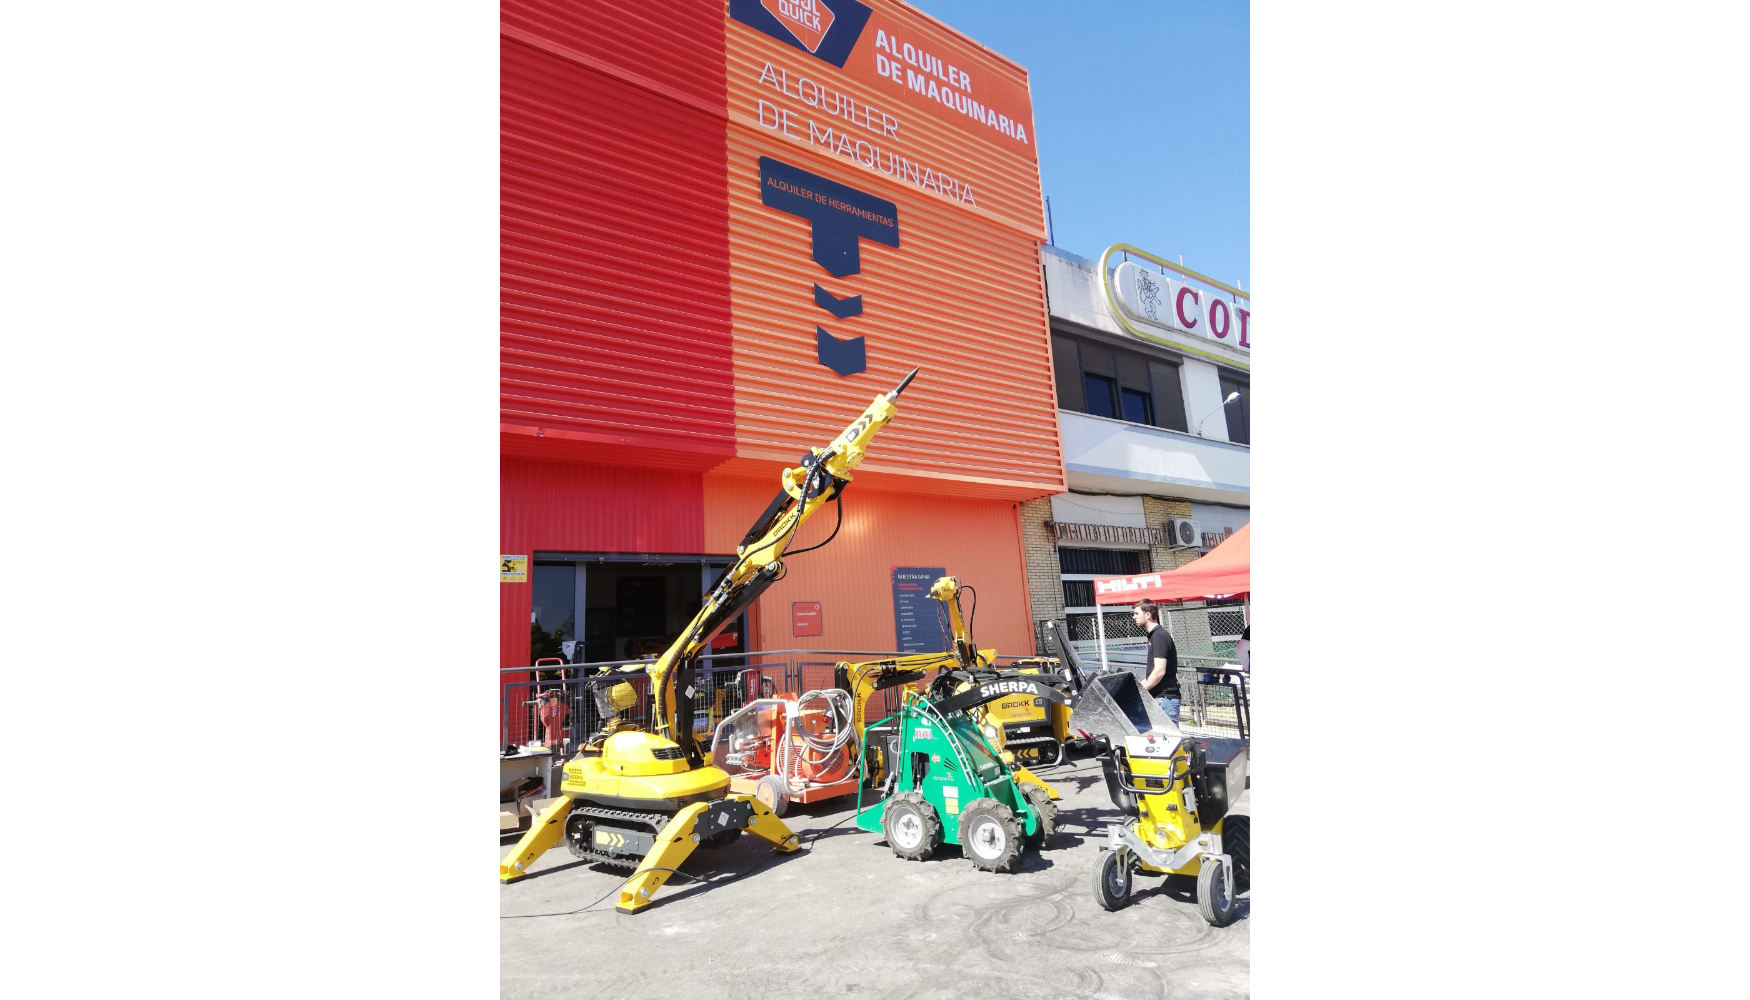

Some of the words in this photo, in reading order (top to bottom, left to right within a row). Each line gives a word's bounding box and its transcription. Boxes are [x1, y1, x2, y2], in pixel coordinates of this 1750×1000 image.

[778, 0, 821, 32] QUICK
[875, 28, 972, 94] ALQUILER
[758, 61, 899, 142] ALQUILER
[876, 53, 903, 85] DE
[907, 68, 1028, 145] MAQUINARIA
[758, 98, 800, 141] DE
[809, 119, 978, 209] MAQUINARIA
[767, 176, 813, 201] ALQUILER
[814, 193, 827, 206] DE
[828, 199, 894, 228] HERRAMIENTAS
[773, 512, 796, 537] BROKK
[1097, 574, 1162, 594] HILTI
[980, 681, 1039, 698] SHERPA
[1001, 700, 1031, 710] BROKK
